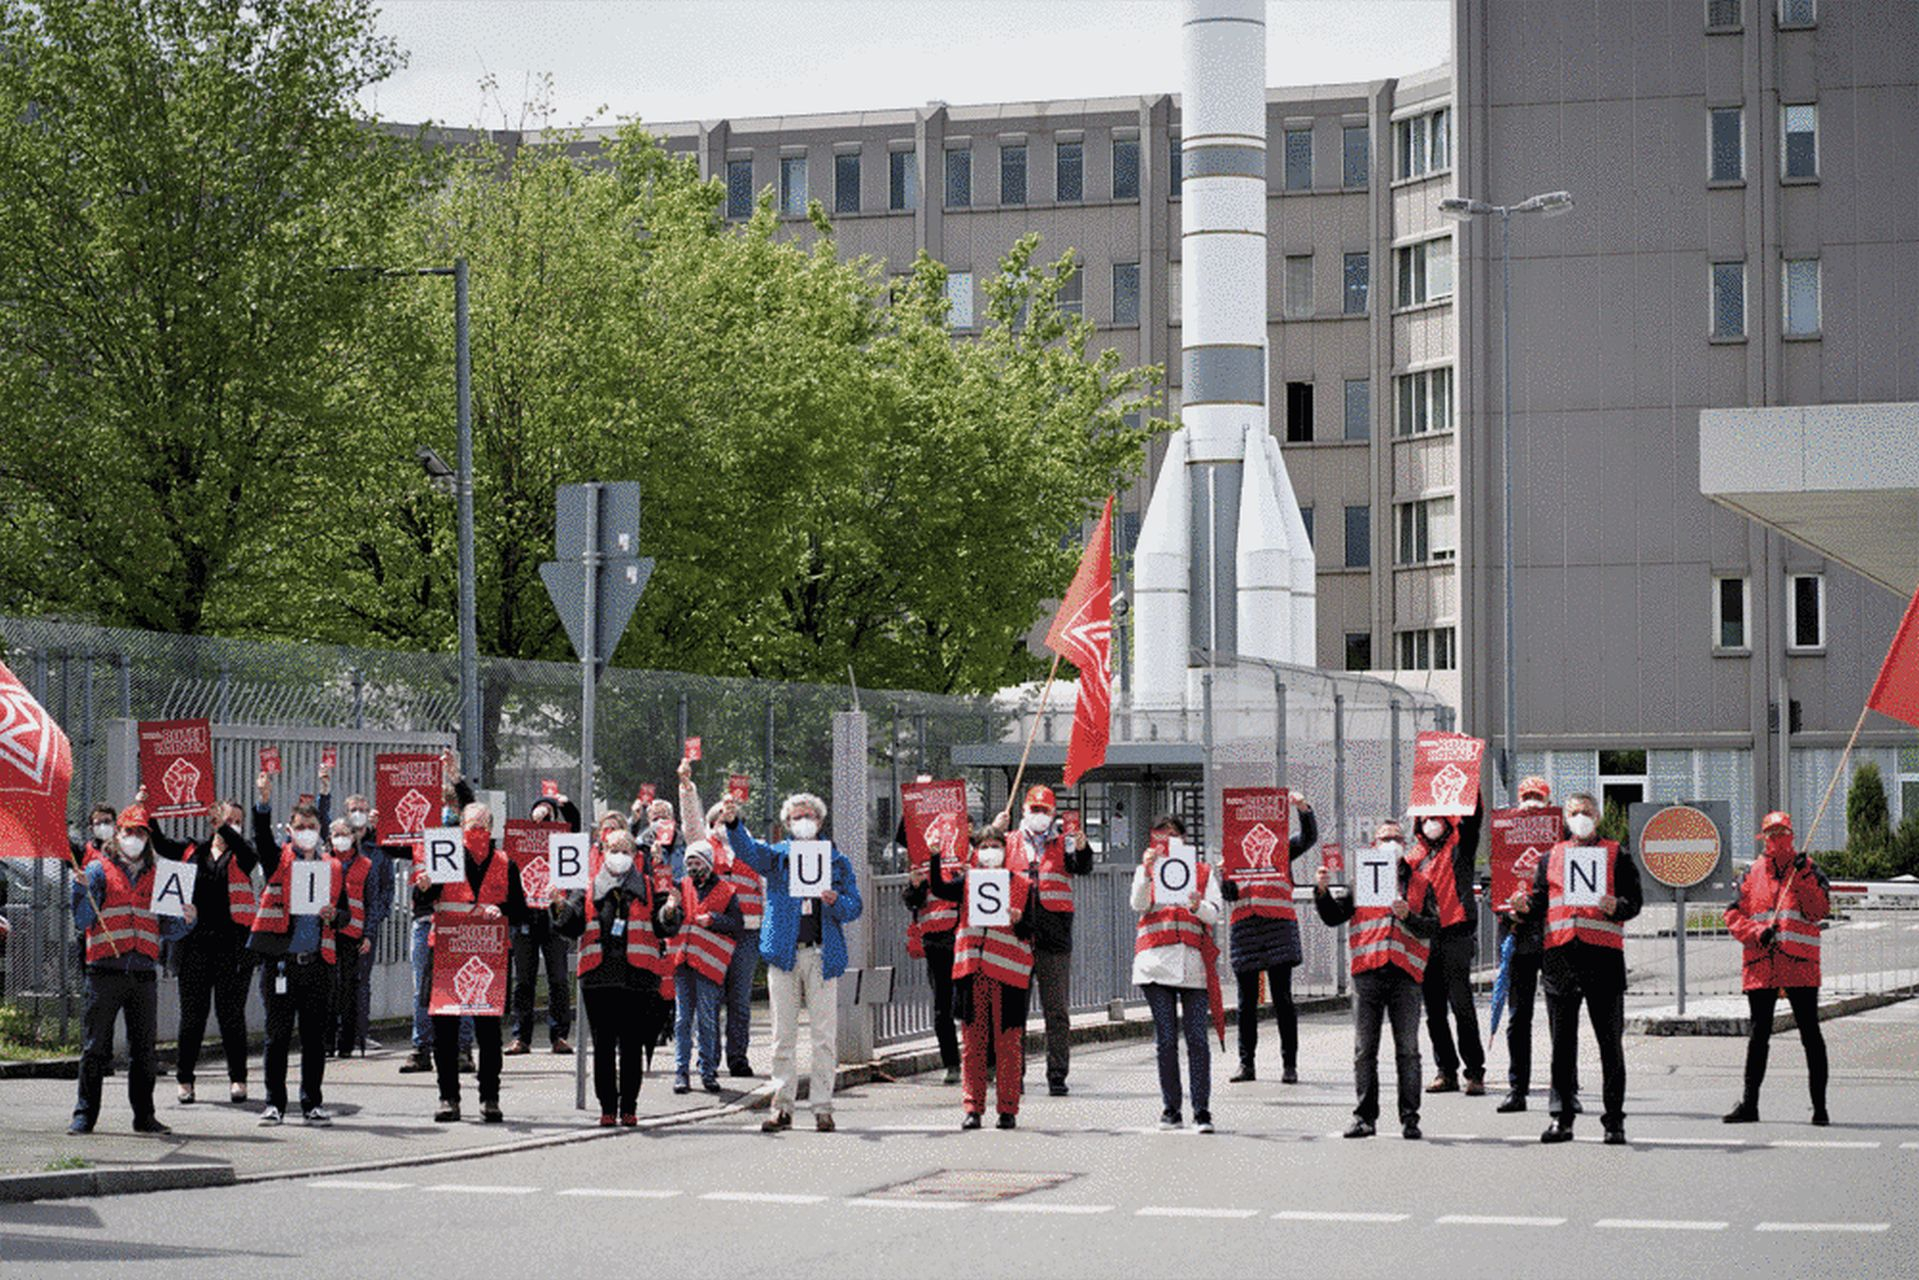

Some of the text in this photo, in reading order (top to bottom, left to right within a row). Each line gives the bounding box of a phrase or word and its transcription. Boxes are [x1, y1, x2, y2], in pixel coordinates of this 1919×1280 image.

[431, 840, 458, 872] R
[558, 845, 581, 877] B
[797, 853, 823, 886] U
[157, 872, 186, 906] A
[309, 872, 315, 903] I
[1159, 858, 1191, 891] O
[1363, 861, 1389, 894] T
[1570, 859, 1597, 893] N
[977, 882, 1002, 915] S
